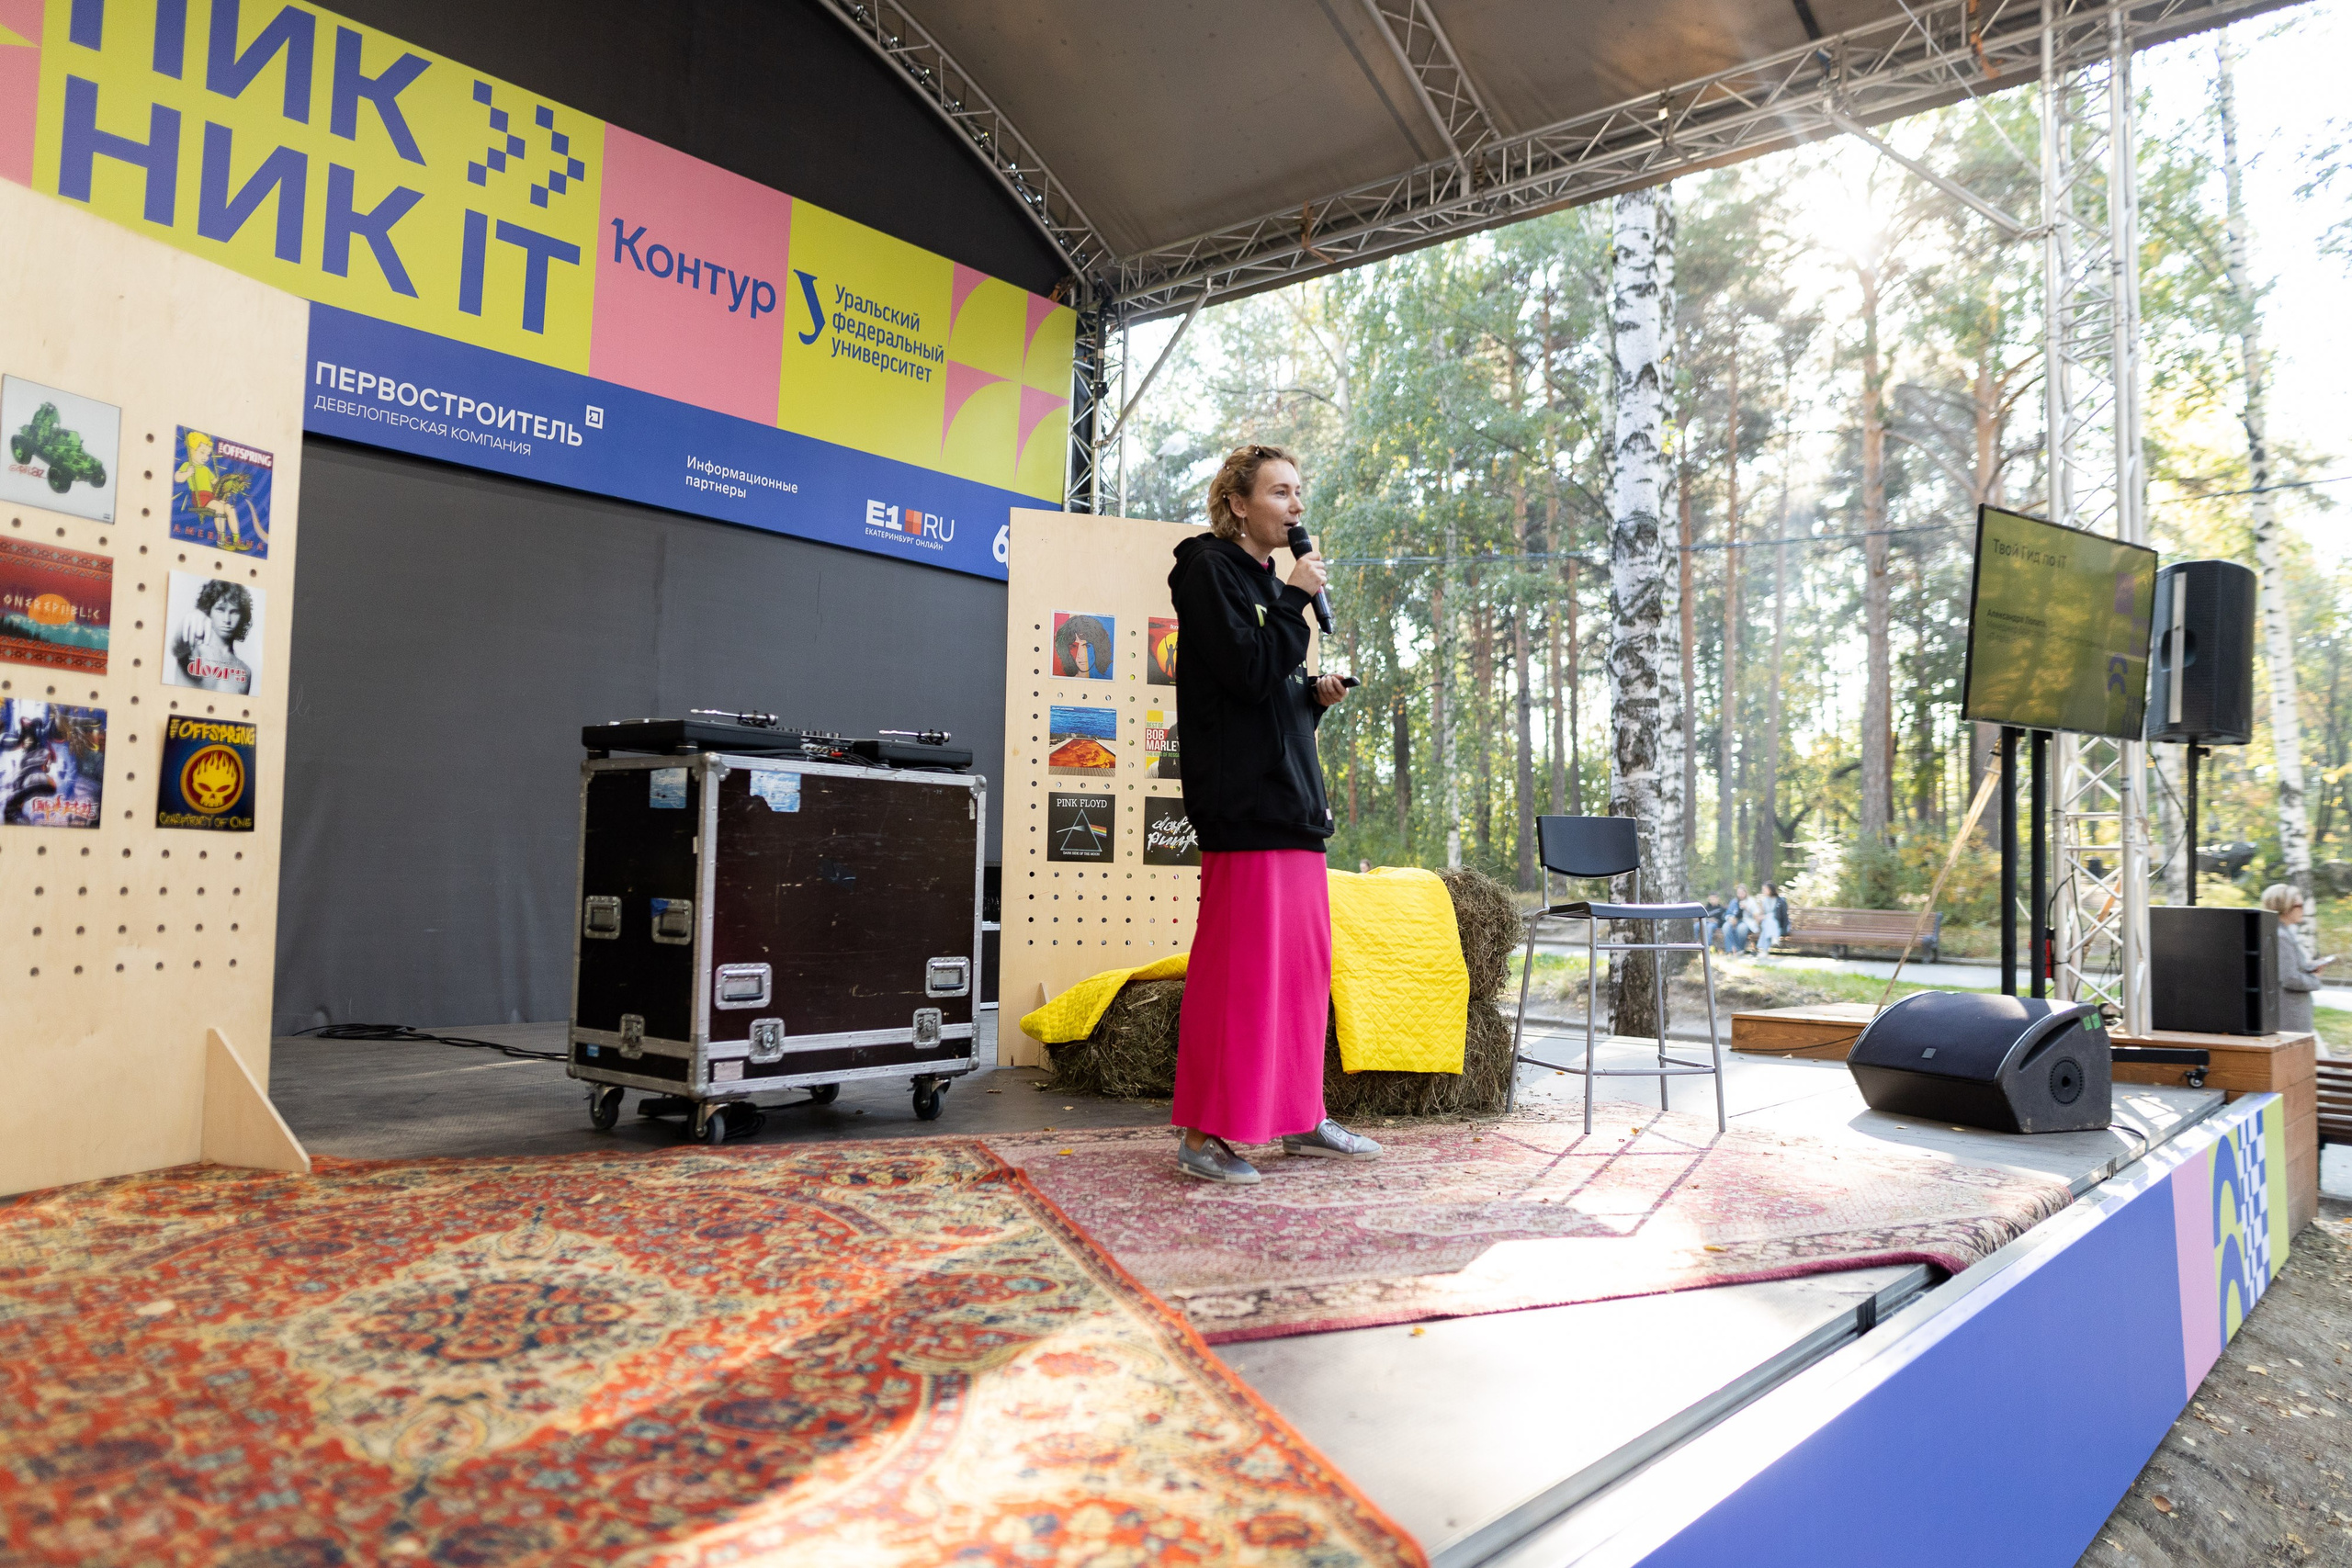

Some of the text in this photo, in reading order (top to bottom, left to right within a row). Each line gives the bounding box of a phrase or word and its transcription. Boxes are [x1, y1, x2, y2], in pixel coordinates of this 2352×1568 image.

[58, 73, 581, 334] НИК IT
[611, 218, 776, 319] Контур
[835, 284, 921, 333] Уральский
[832, 312, 944, 364] федеральный
[831, 337, 933, 383] университет
[315, 361, 583, 447] ПЕРВОСТРОИТЕЛЬ
[313, 395, 532, 457] ДЕВЕЛОПЕРСКАЯ КОМПАНИЯ
[222, 444, 272, 468] OFFSPRING
[686, 455, 798, 494] Информационные
[685, 475, 747, 499] партнеры
[865, 527, 944, 551] ЕКАТЕРИНБУРГ ОНЛАЙН
[1993, 538, 2018, 558] Твой
[187, 657, 246, 682] doors
[1146, 729, 1165, 740] BOB
[1056, 798, 1108, 808] PINK FLOYD
